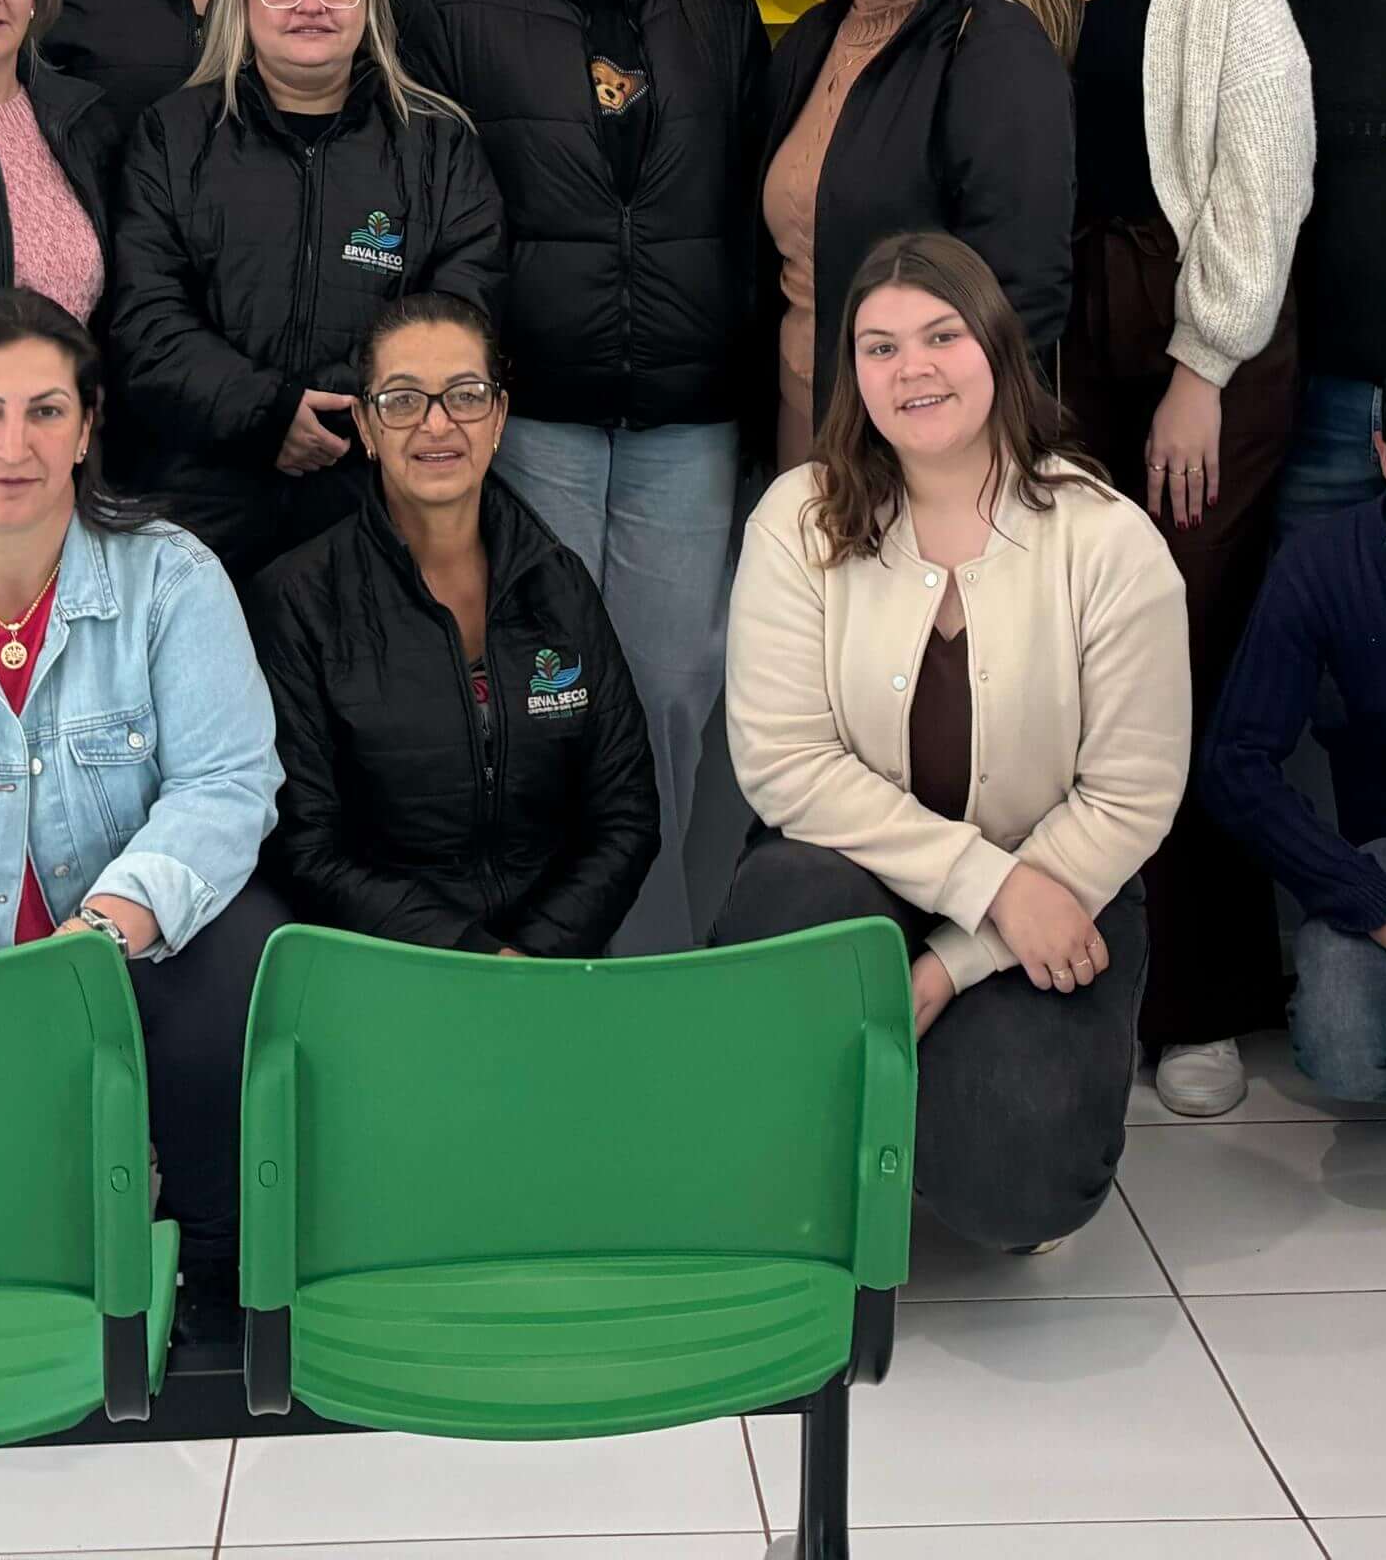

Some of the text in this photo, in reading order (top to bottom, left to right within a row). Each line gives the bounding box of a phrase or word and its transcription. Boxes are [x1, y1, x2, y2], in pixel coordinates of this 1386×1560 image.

[344, 244, 378, 260] ERVAL
[378, 251, 403, 266] SECO
[527, 693, 559, 709] ERVAL
[558, 687, 588, 705] SECO
